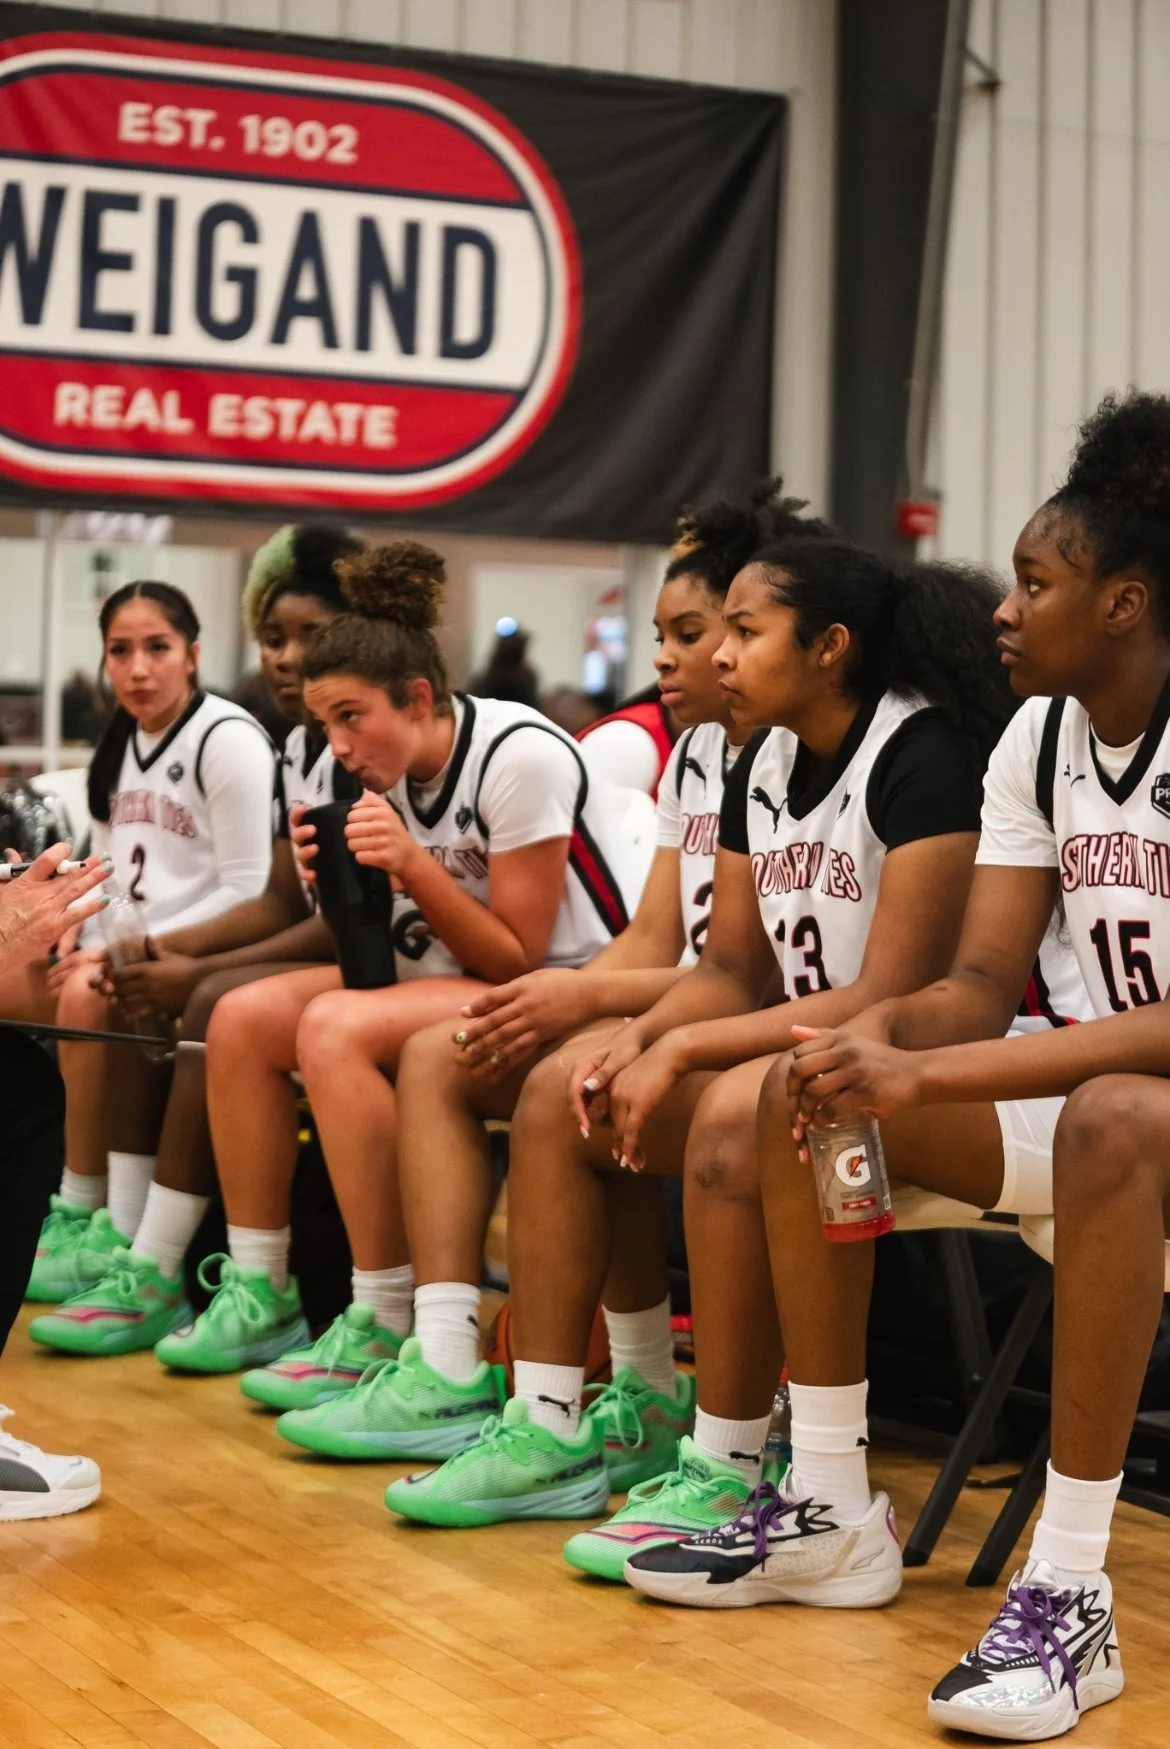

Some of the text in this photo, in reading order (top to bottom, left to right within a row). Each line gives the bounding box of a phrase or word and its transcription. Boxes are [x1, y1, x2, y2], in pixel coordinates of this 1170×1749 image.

[118, 101, 359, 164] EST. 1902
[0, 181, 497, 360] WEIGAND
[53, 381, 397, 447] REAL ESTATE
[131, 843, 147, 902] 2
[1089, 918, 1162, 1013] 15
[835, 1144, 871, 1187] G
